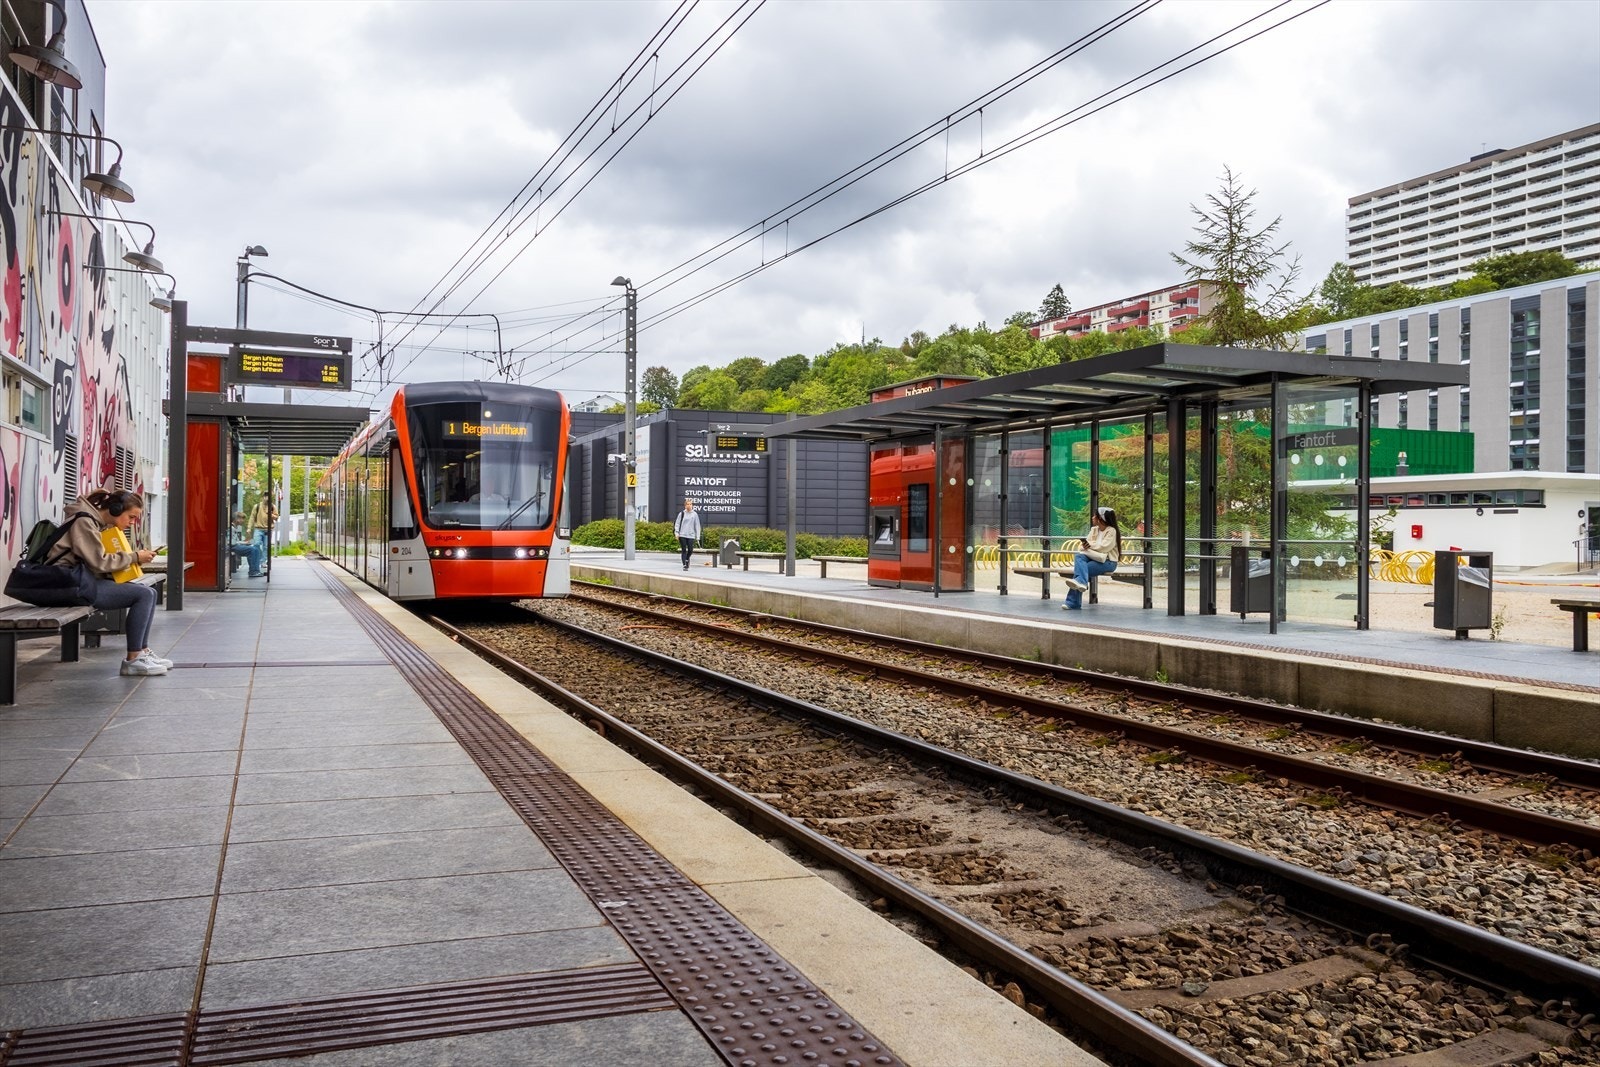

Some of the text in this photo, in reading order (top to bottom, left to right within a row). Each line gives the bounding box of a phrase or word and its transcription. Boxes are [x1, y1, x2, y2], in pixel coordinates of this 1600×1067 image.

[313, 336, 330, 344] Spor
[332, 338, 338, 348] 1
[449, 423, 455, 434] 1
[462, 422, 492, 436] Bergen
[1294, 432, 1336, 448] Fantoft
[630, 474, 635, 486] 2
[684, 477, 728, 486] FANTOFT
[401, 547, 412, 555] 204
